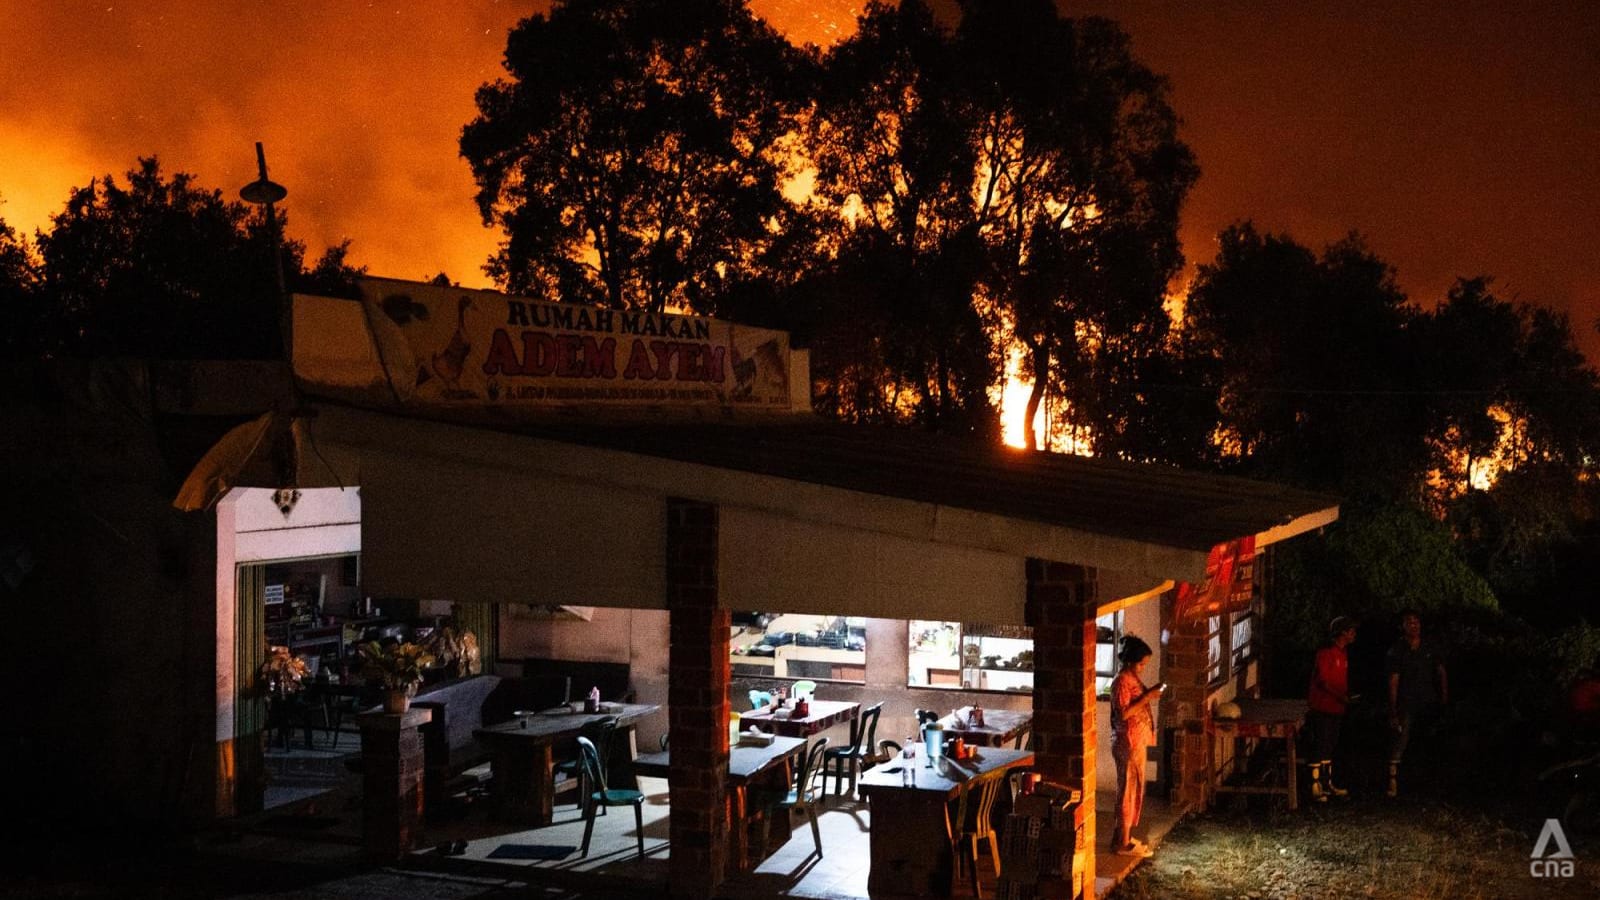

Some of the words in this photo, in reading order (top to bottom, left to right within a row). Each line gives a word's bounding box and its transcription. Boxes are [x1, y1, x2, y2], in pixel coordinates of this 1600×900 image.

[507, 301, 613, 332] RUMAH
[621, 312, 710, 339] MAKAN
[483, 328, 617, 380] ADEM
[623, 338, 726, 383] AYEM
